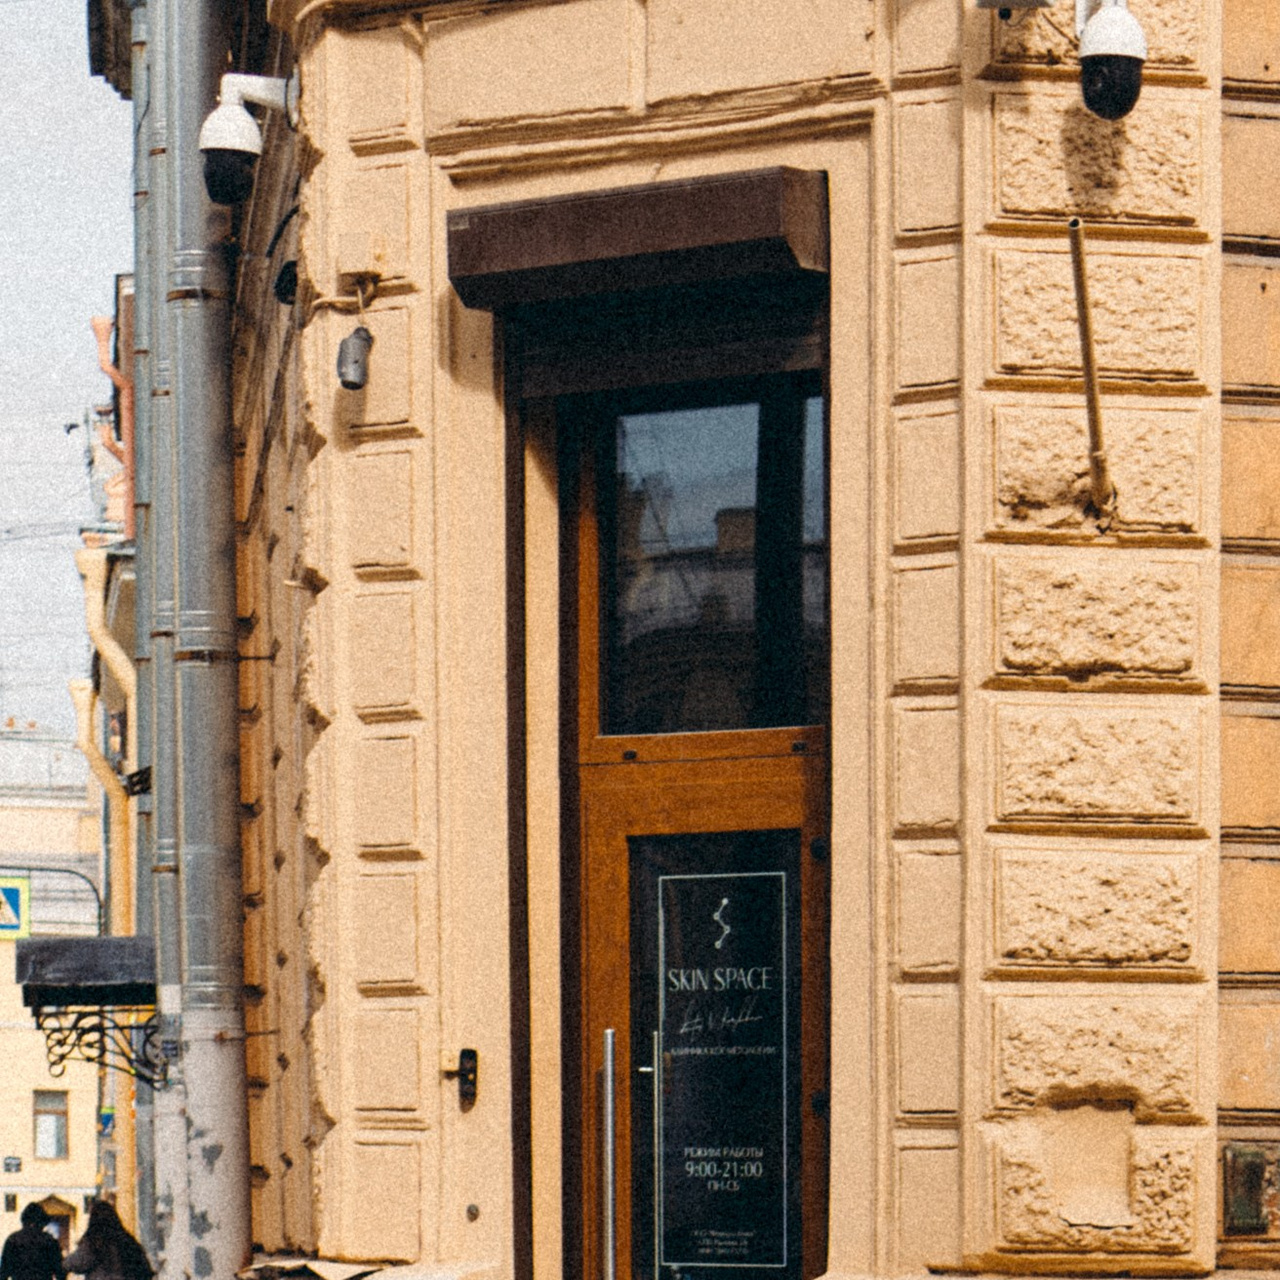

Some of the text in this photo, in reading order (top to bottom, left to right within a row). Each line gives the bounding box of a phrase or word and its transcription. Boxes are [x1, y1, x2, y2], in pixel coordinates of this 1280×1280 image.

[667, 965, 774, 992] SKIN SPACE
[722, 1146, 764, 1158] РАБОТЫ
[685, 1161, 763, 1177] 9:00-21:00
